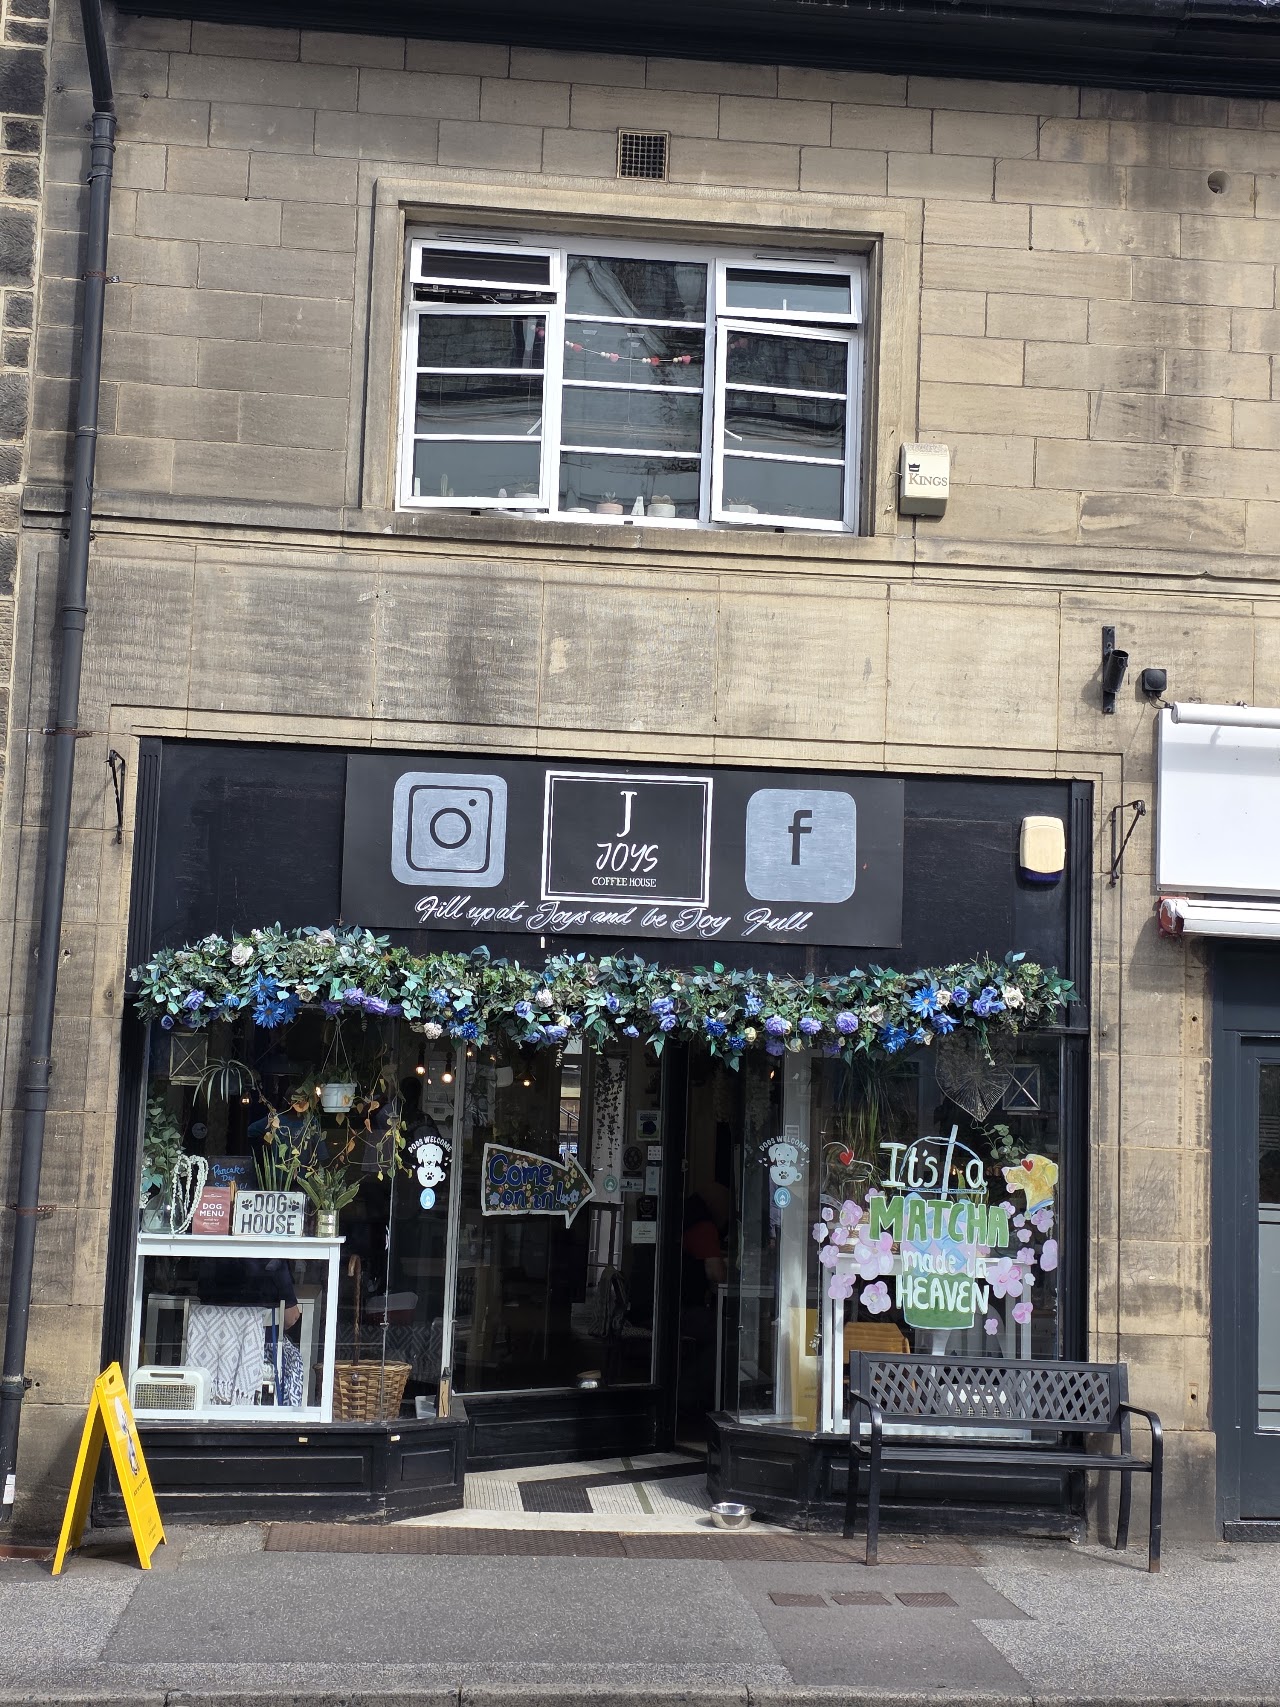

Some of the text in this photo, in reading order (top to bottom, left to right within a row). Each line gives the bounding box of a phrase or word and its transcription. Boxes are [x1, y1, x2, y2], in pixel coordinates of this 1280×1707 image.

[908, 472, 948, 487] KINGS
[616, 790, 638, 838] J
[595, 842, 659, 873] JOYS
[591, 876, 657, 888] COFFEE HOUSE
[415, 894, 471, 923] Fill
[526, 900, 590, 932] Joys
[640, 907, 668, 928] be
[741, 908, 813, 936] Full
[423, 1135, 453, 1153] WELCOME
[776, 1135, 810, 1153] WELCOME
[211, 1164, 246, 1178] Pancake
[488, 1153, 553, 1187] Come
[879, 1142, 989, 1188] It's a
[254, 1195, 288, 1214] DOG
[501, 1181, 565, 1210] on in!
[241, 1215, 296, 1234] HOUSE
[869, 1195, 1010, 1248] MATCHA
[902, 1248, 989, 1278] made in
[896, 1273, 990, 1315] HEAVEN
